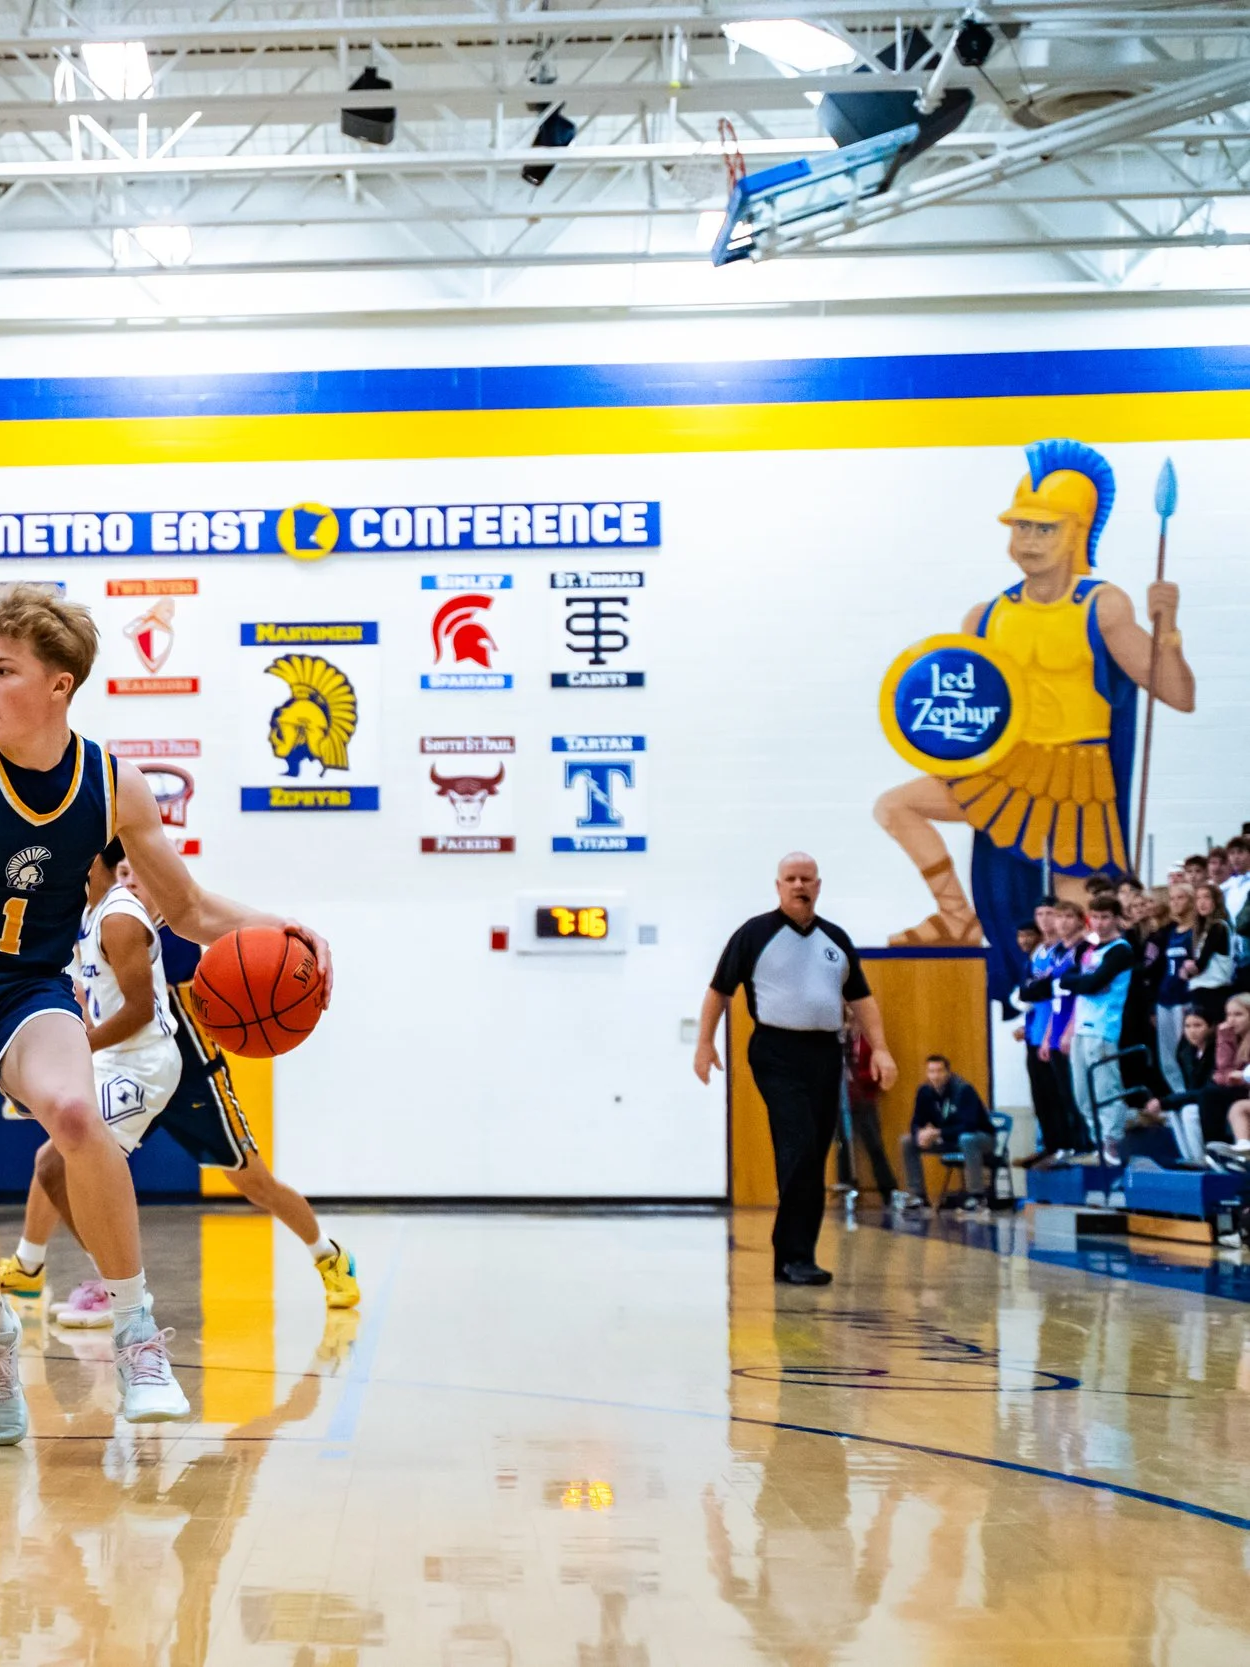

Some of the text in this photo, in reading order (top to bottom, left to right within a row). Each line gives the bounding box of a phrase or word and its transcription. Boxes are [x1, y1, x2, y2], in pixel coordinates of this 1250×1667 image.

[151, 510, 265, 552] EAST
[350, 502, 649, 548] CONFERENCE
[566, 671, 628, 687] CADETS
[931, 662, 976, 698] Led
[910, 697, 1001, 743] Zephyr
[563, 735, 633, 750] TARTAN
[269, 786, 352, 807] ZEPHYRS
[551, 906, 607, 938] 7:16
